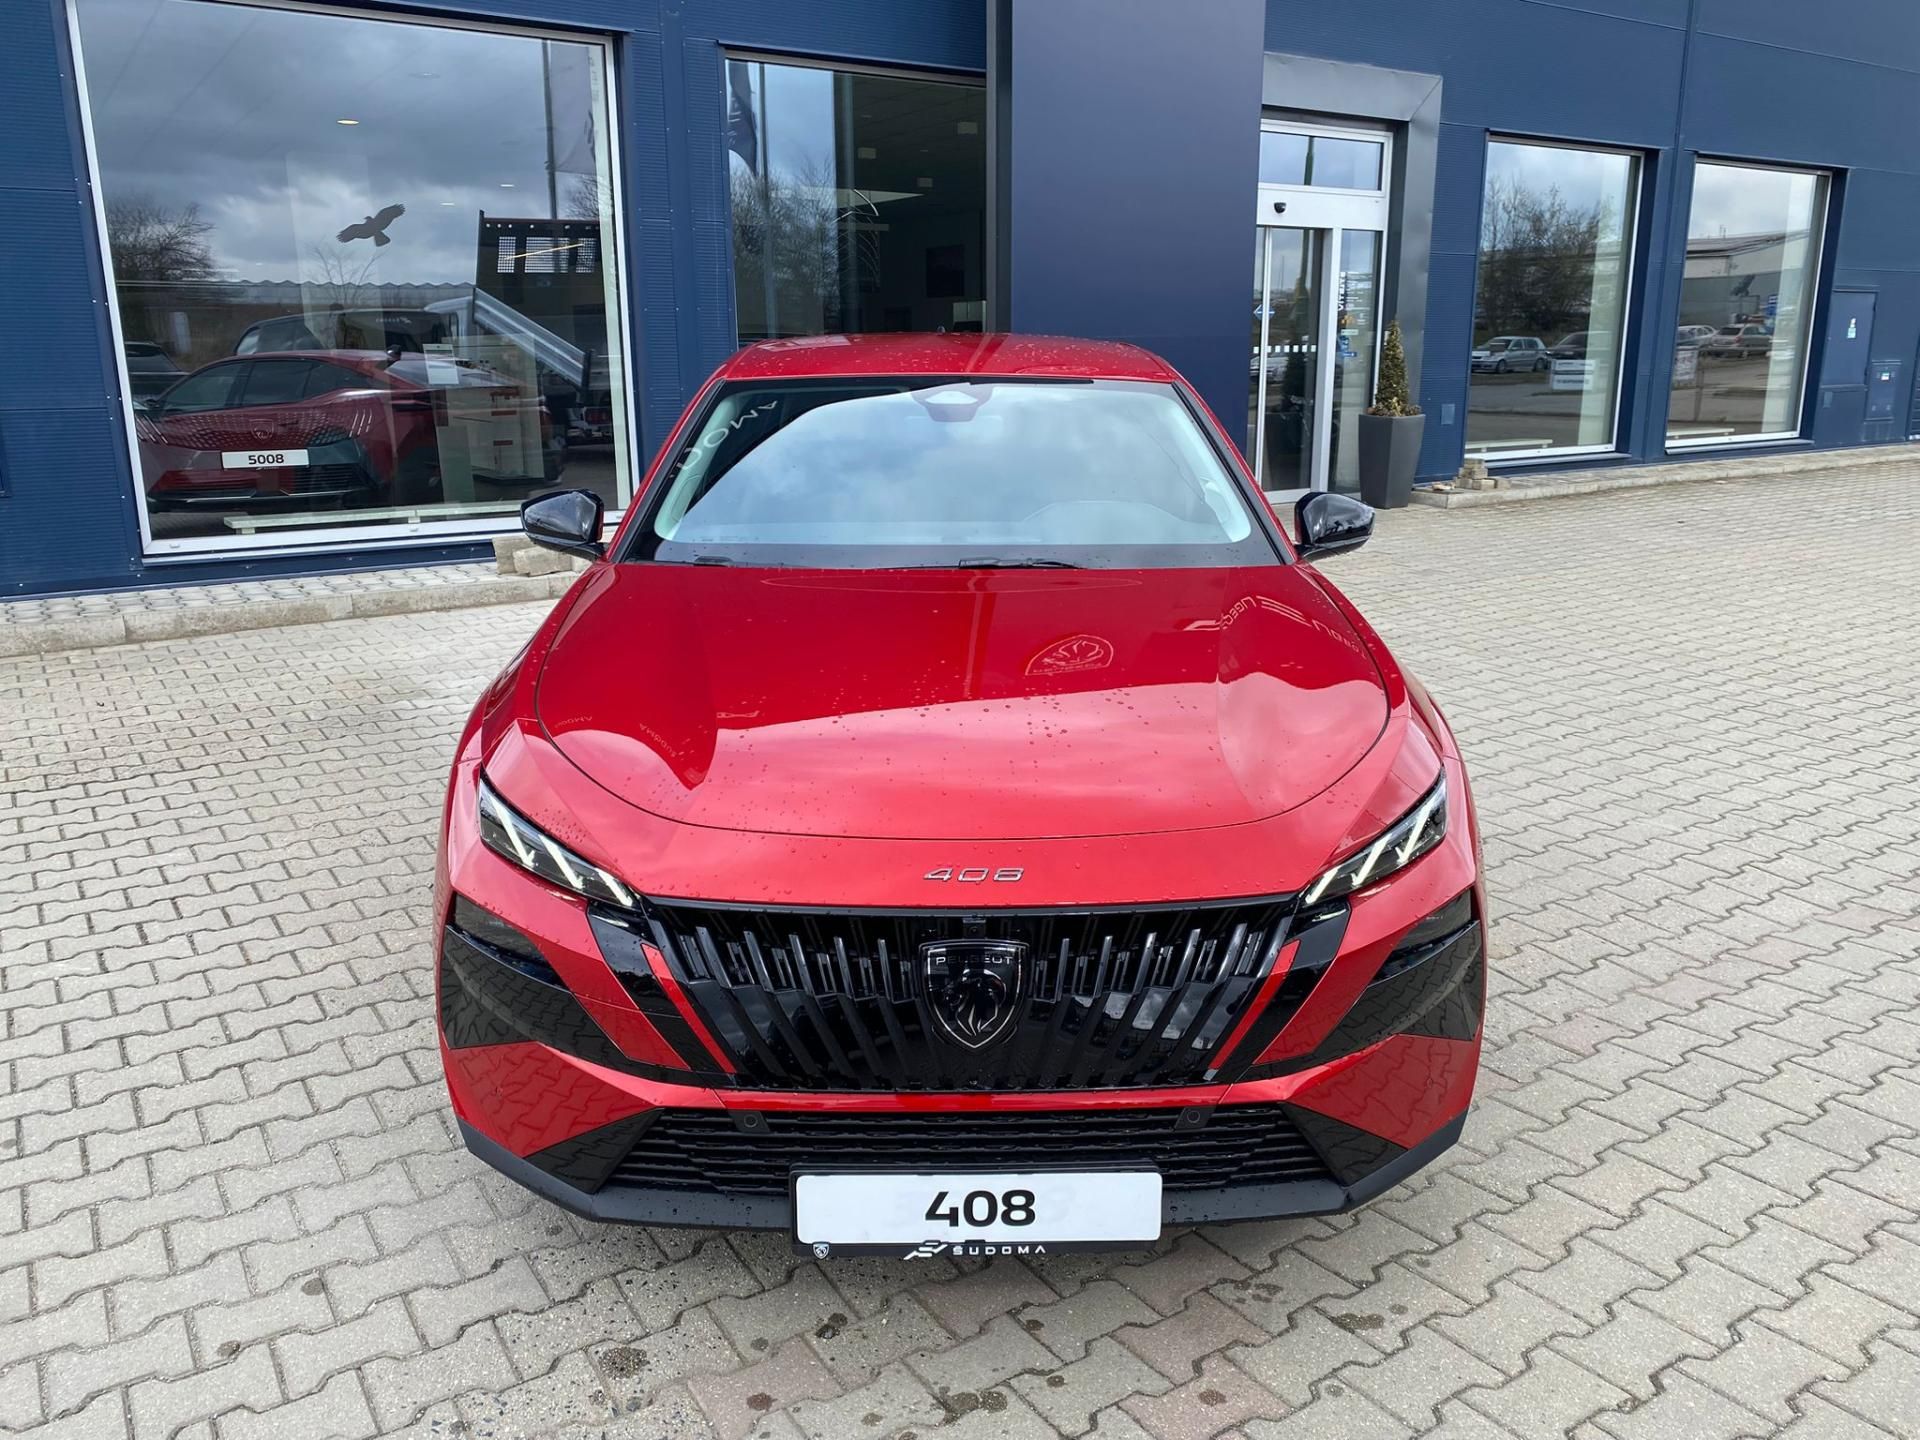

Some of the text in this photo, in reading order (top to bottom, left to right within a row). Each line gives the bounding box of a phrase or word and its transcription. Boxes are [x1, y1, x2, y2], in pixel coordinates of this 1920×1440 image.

[248, 454, 284, 465] 5008
[924, 868, 1024, 882] 408
[925, 1189, 1036, 1227] 408
[953, 1246, 1047, 1256] SUDOMA
